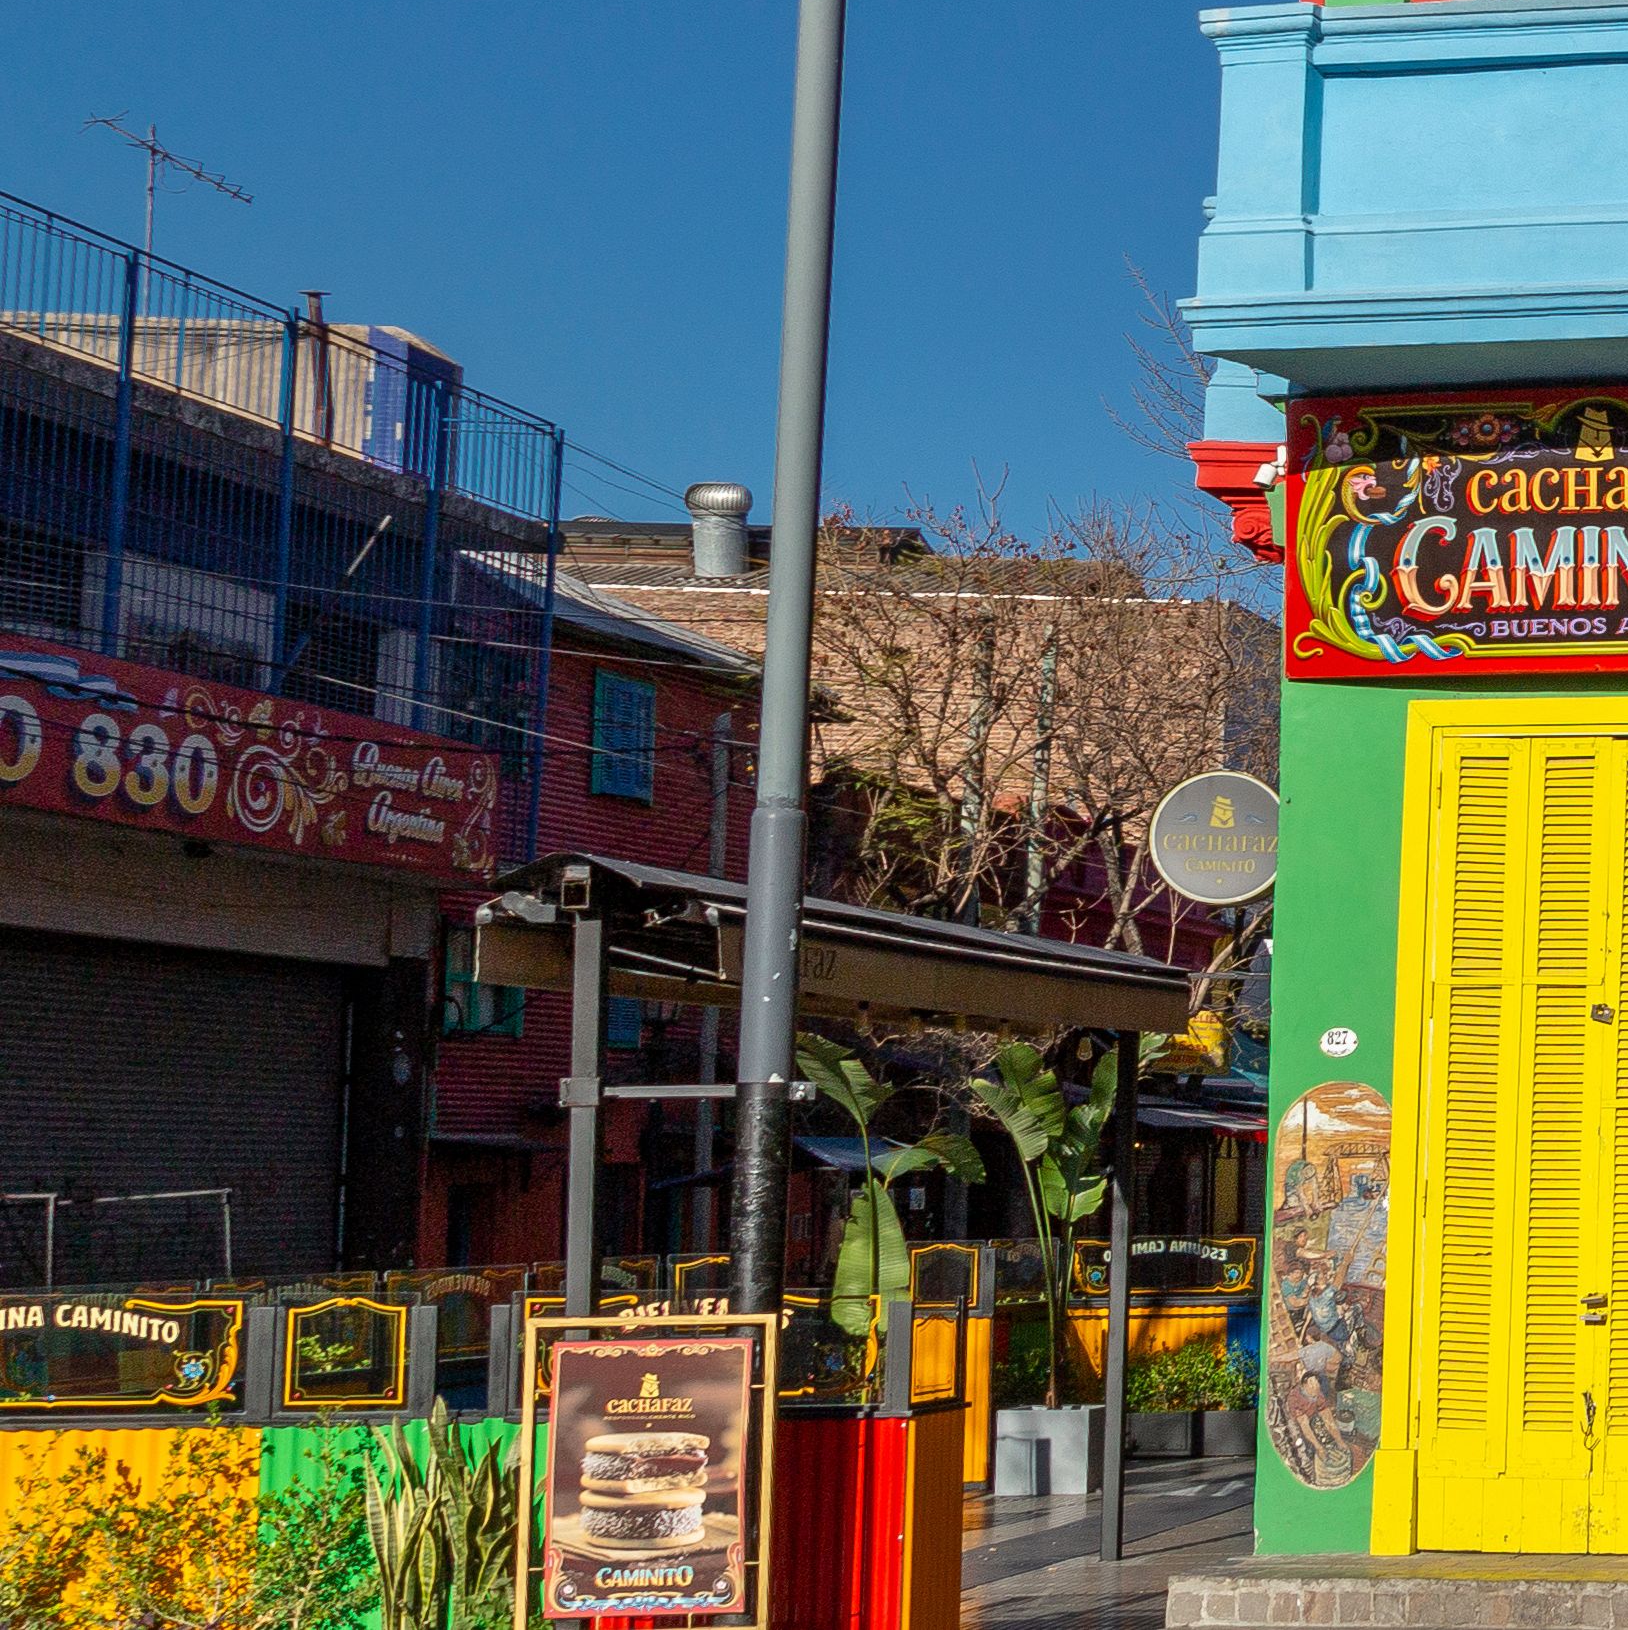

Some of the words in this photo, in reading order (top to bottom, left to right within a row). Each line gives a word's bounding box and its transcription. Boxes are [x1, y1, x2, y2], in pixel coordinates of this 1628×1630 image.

[1490, 615, 1607, 638] BUENOS
[73, 713, 219, 814] 830
[1185, 856, 1255, 874] CAMINITO
[1327, 1031, 1348, 1046] 827
[55, 1304, 180, 1343] CAMINITO
[595, 1565, 694, 1589] CAMINITO
